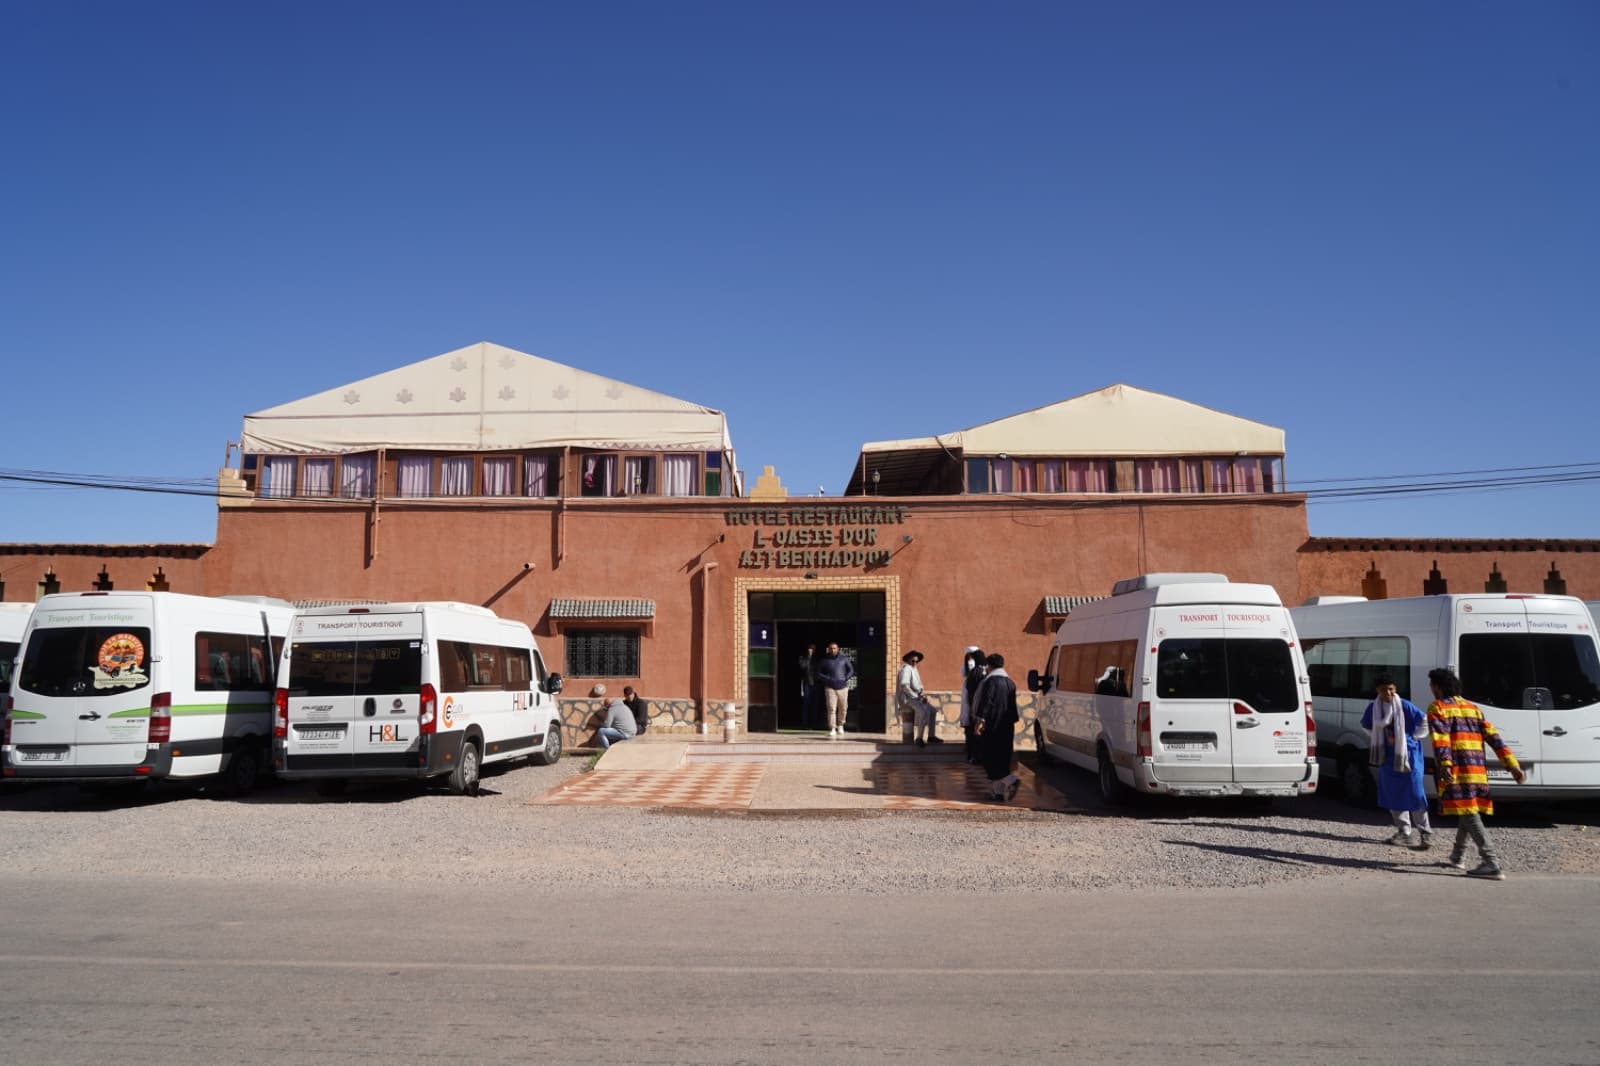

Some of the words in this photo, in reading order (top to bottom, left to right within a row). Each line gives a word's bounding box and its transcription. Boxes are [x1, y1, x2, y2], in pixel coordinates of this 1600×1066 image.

[727, 507, 786, 525] HOTEL
[791, 505, 908, 525] RESTAURANT
[776, 527, 834, 545] OASIS
[740, 548, 775, 567] AIT
[47, 613, 85, 624] Transport
[89, 612, 134, 624] Touristique
[317, 621, 357, 630] TRANSPORT
[359, 620, 403, 630] TOURISTIQUE
[1178, 613, 1219, 623] TRANSPORT
[1226, 613, 1272, 624] TOURISTIQUE
[1484, 620, 1522, 629] Transport
[1528, 620, 1569, 630] Touristique
[369, 723, 409, 742] H&L
